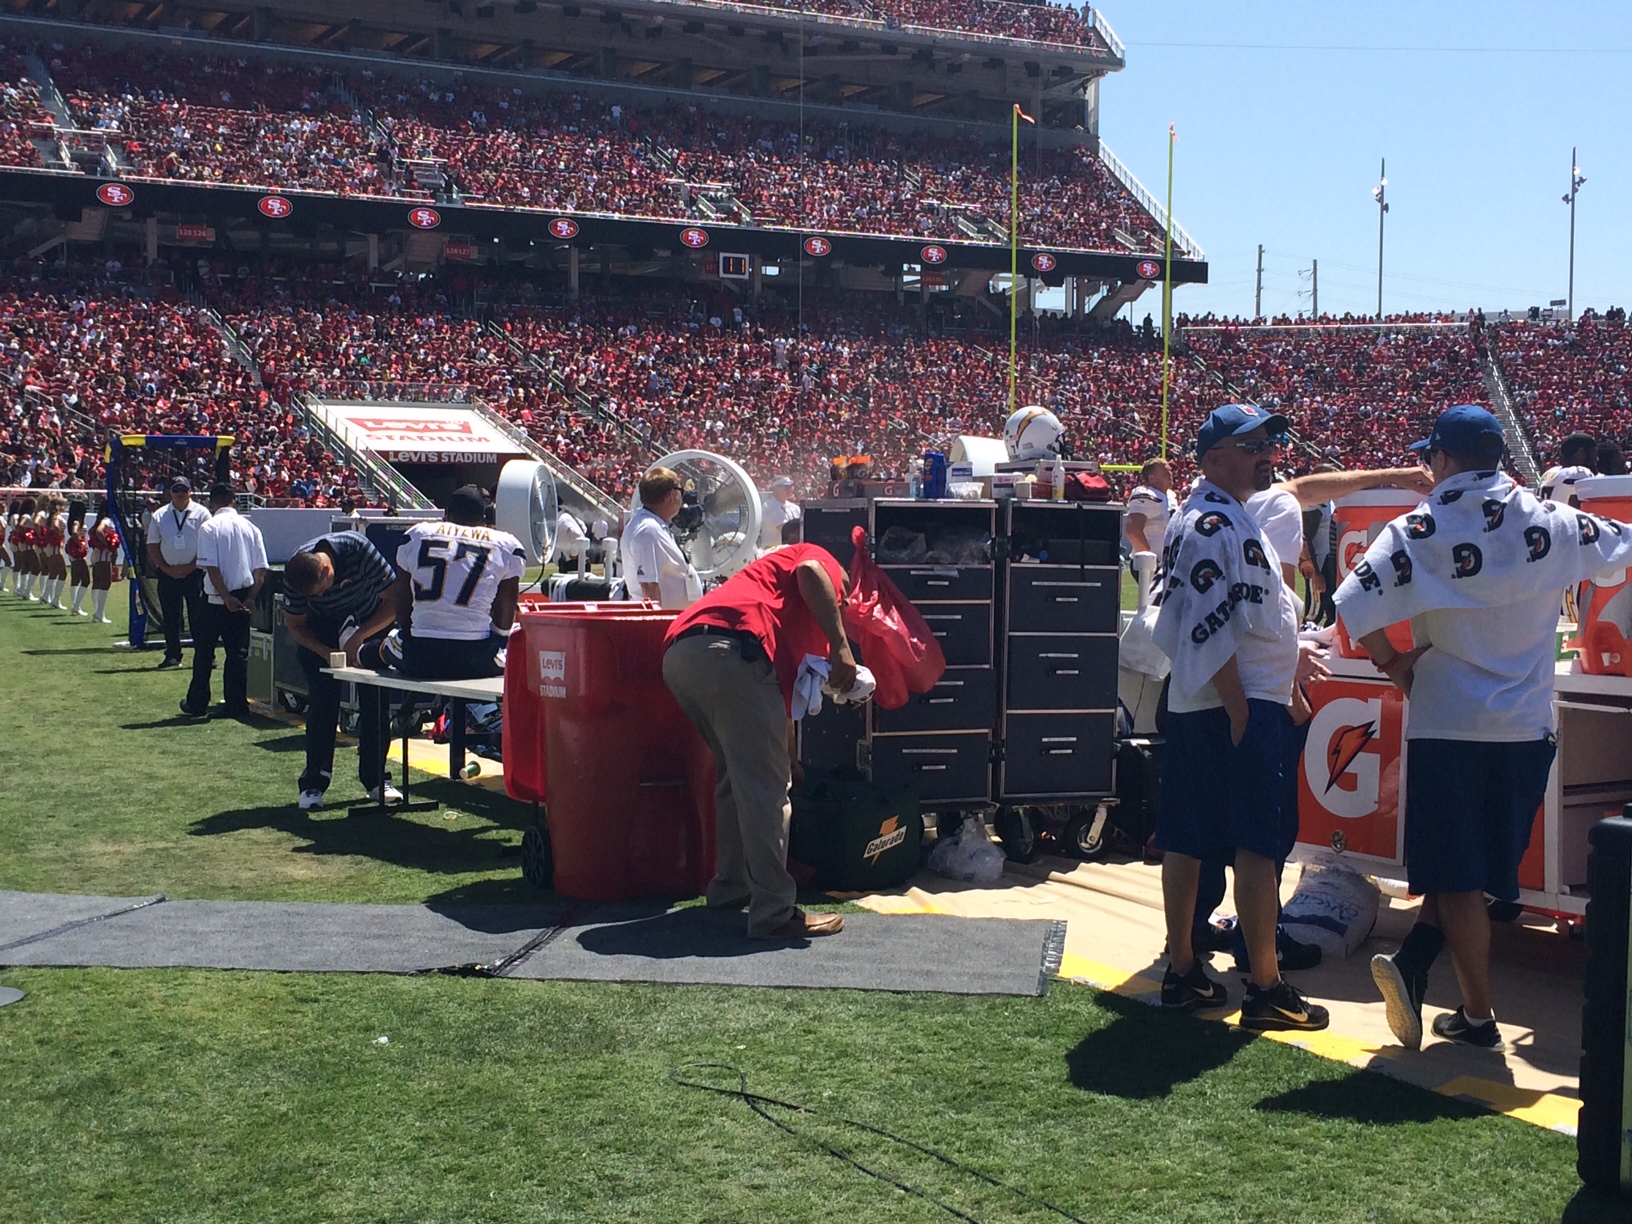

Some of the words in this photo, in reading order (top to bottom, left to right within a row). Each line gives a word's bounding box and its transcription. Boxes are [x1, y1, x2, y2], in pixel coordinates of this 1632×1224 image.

[179, 228, 192, 237] 125
[365, 434, 491, 443] STADIUM
[441, 452, 498, 464] STADIUM
[833, 482, 840, 497] G
[884, 485, 894, 496] G
[413, 535, 495, 609] 57
[1190, 559, 1224, 594] G
[540, 684, 567, 699] STADIUM
[1304, 697, 1382, 819] G
[866, 830, 905, 855] Gatorade
